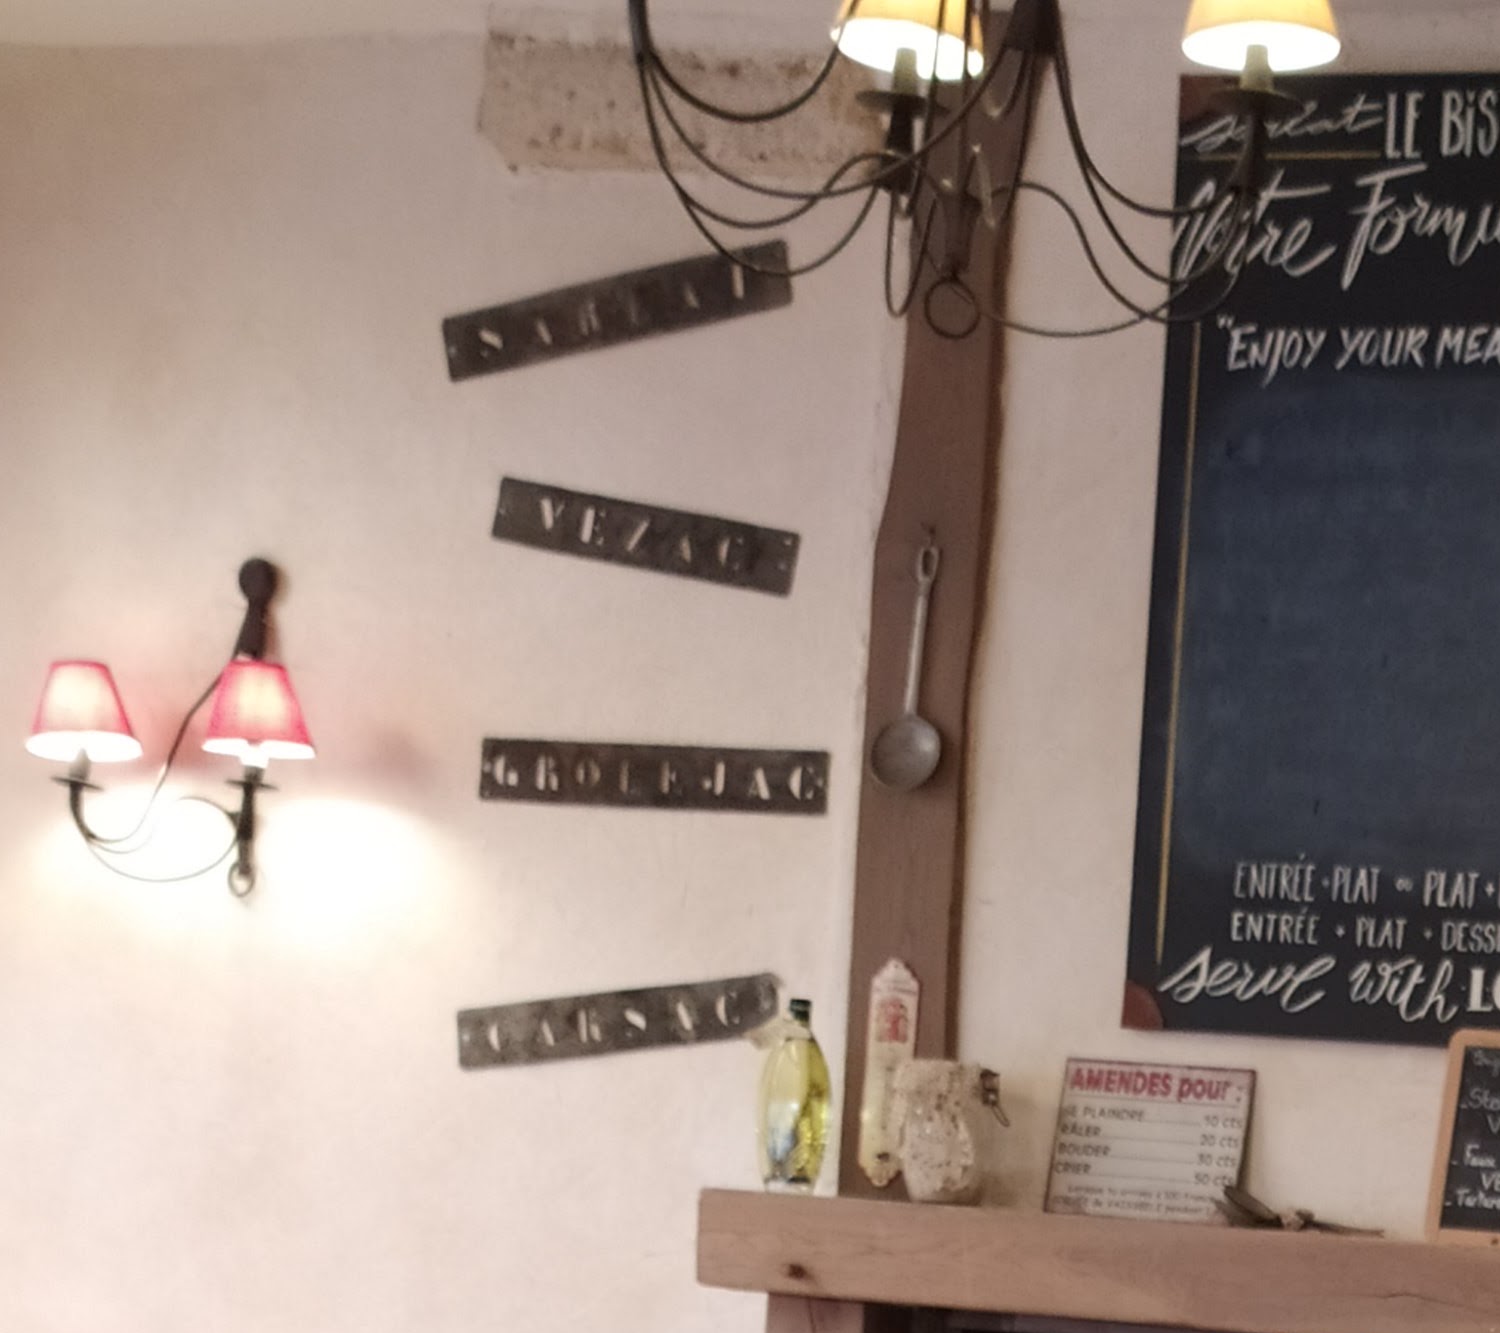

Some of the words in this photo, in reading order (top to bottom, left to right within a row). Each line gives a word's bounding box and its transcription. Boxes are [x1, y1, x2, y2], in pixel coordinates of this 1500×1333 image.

[1385, 90, 1422, 159] LE
[1335, 325, 1429, 371] YOUR
[1234, 852, 1317, 902] ENTRÉE
[1331, 863, 1382, 904] PLAT
[1423, 868, 1479, 910] PLAT
[1230, 907, 1321, 945] ENTRÉE
[1355, 916, 1408, 950] PLAT
[1350, 954, 1460, 1023] with
[1070, 1067, 1173, 1097] AMENDES
[1177, 1077, 1233, 1103] pour
